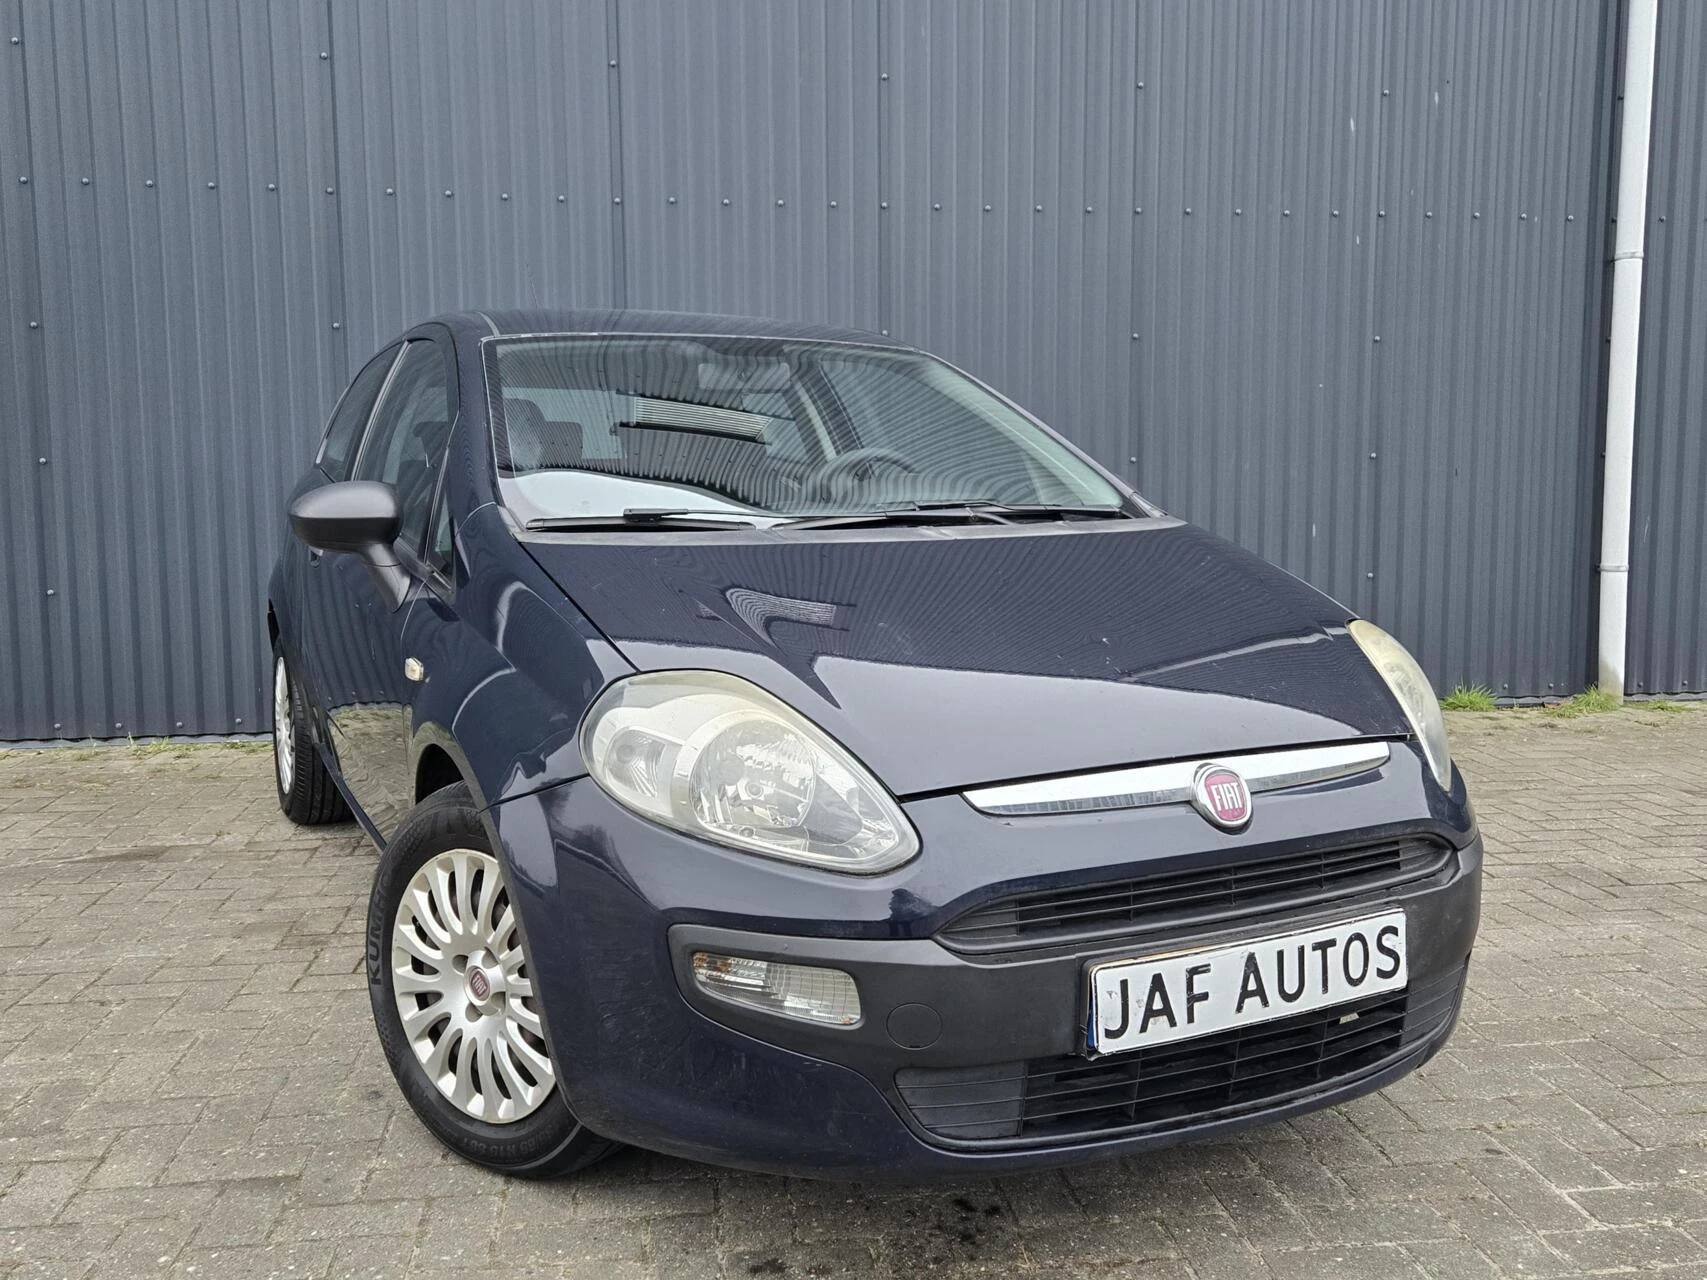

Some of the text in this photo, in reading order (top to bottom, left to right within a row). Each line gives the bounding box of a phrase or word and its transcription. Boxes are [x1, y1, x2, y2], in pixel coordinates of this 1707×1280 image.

[1210, 782, 1243, 812] FIAT
[1104, 924, 1401, 1040] JAF AUTOS
